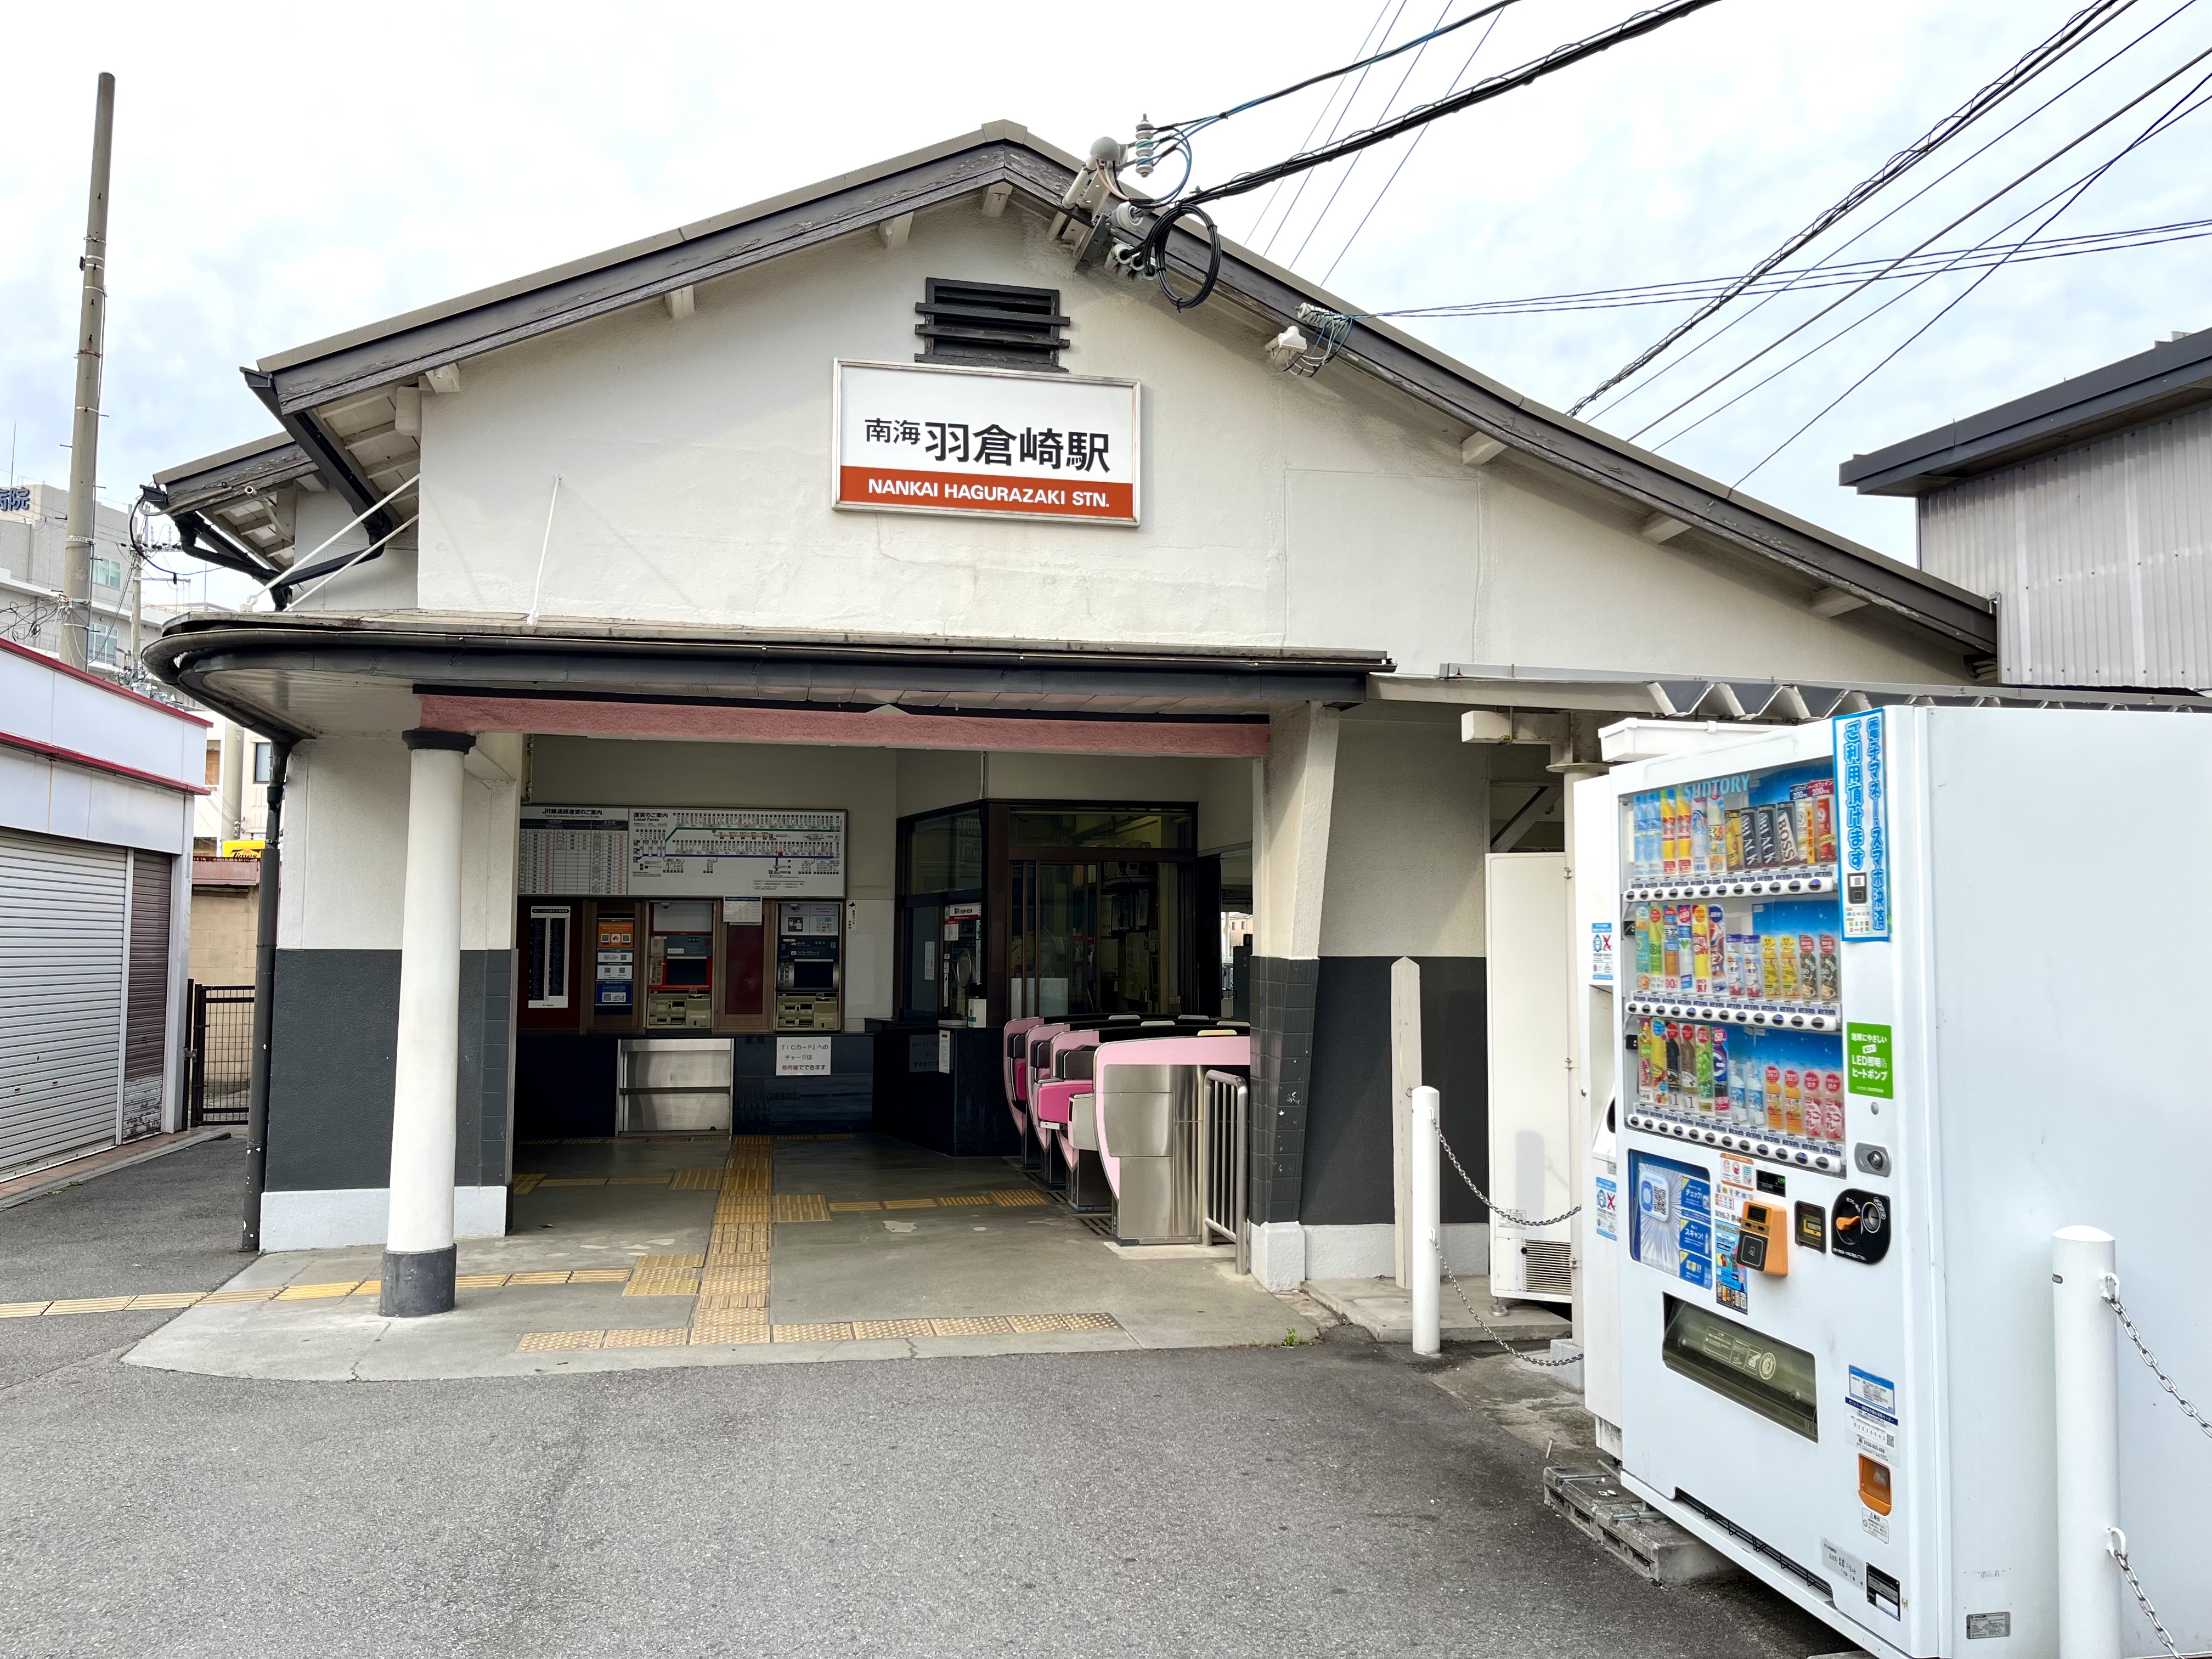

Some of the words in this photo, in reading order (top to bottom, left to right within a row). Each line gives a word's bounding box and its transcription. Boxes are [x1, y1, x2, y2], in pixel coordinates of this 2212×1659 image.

[868, 478, 938, 498] NANKAI
[945, 484, 1065, 505] HAGURAZAKI
[1073, 492, 1109, 507] STN.
[1684, 774, 1750, 799] SUNTORY
[1843, 719, 1864, 871] ご利用頂けます
[1778, 819, 1795, 860] BOSS
[1851, 1032, 1887, 1043] 地球にやさしい
[1852, 1068, 1888, 1081] ヒートポンプ
[1685, 1188, 1703, 1200] チェック!
[1685, 1227, 1703, 1240] スキャン!
